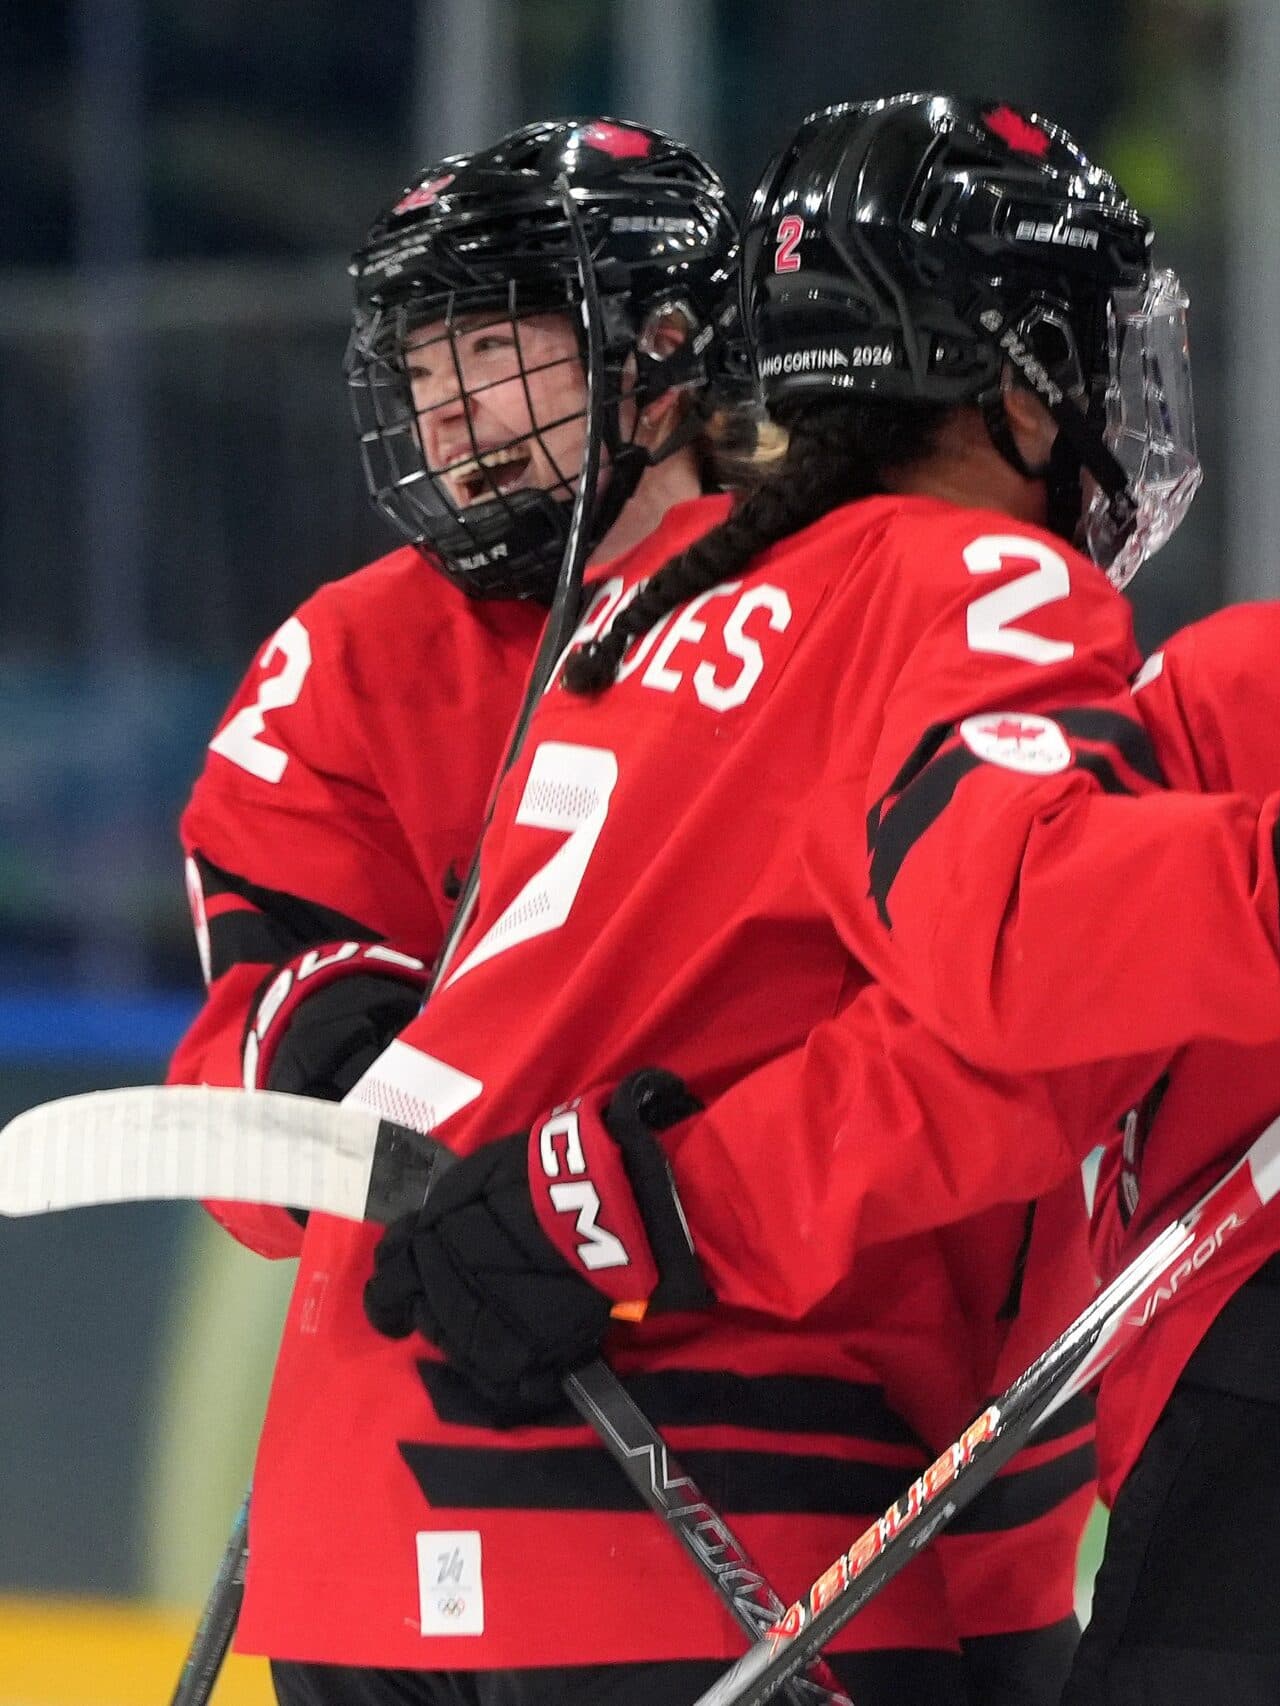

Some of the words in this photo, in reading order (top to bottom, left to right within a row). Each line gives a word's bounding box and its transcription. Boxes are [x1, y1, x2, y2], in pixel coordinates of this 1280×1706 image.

[773, 214, 804, 274] 2
[852, 345, 892, 367] 2026
[962, 534, 1076, 666] 2
[208, 616, 312, 784] 2
[540, 1096, 631, 1272] CM
[1127, 1212, 1247, 1327] VAPOR
